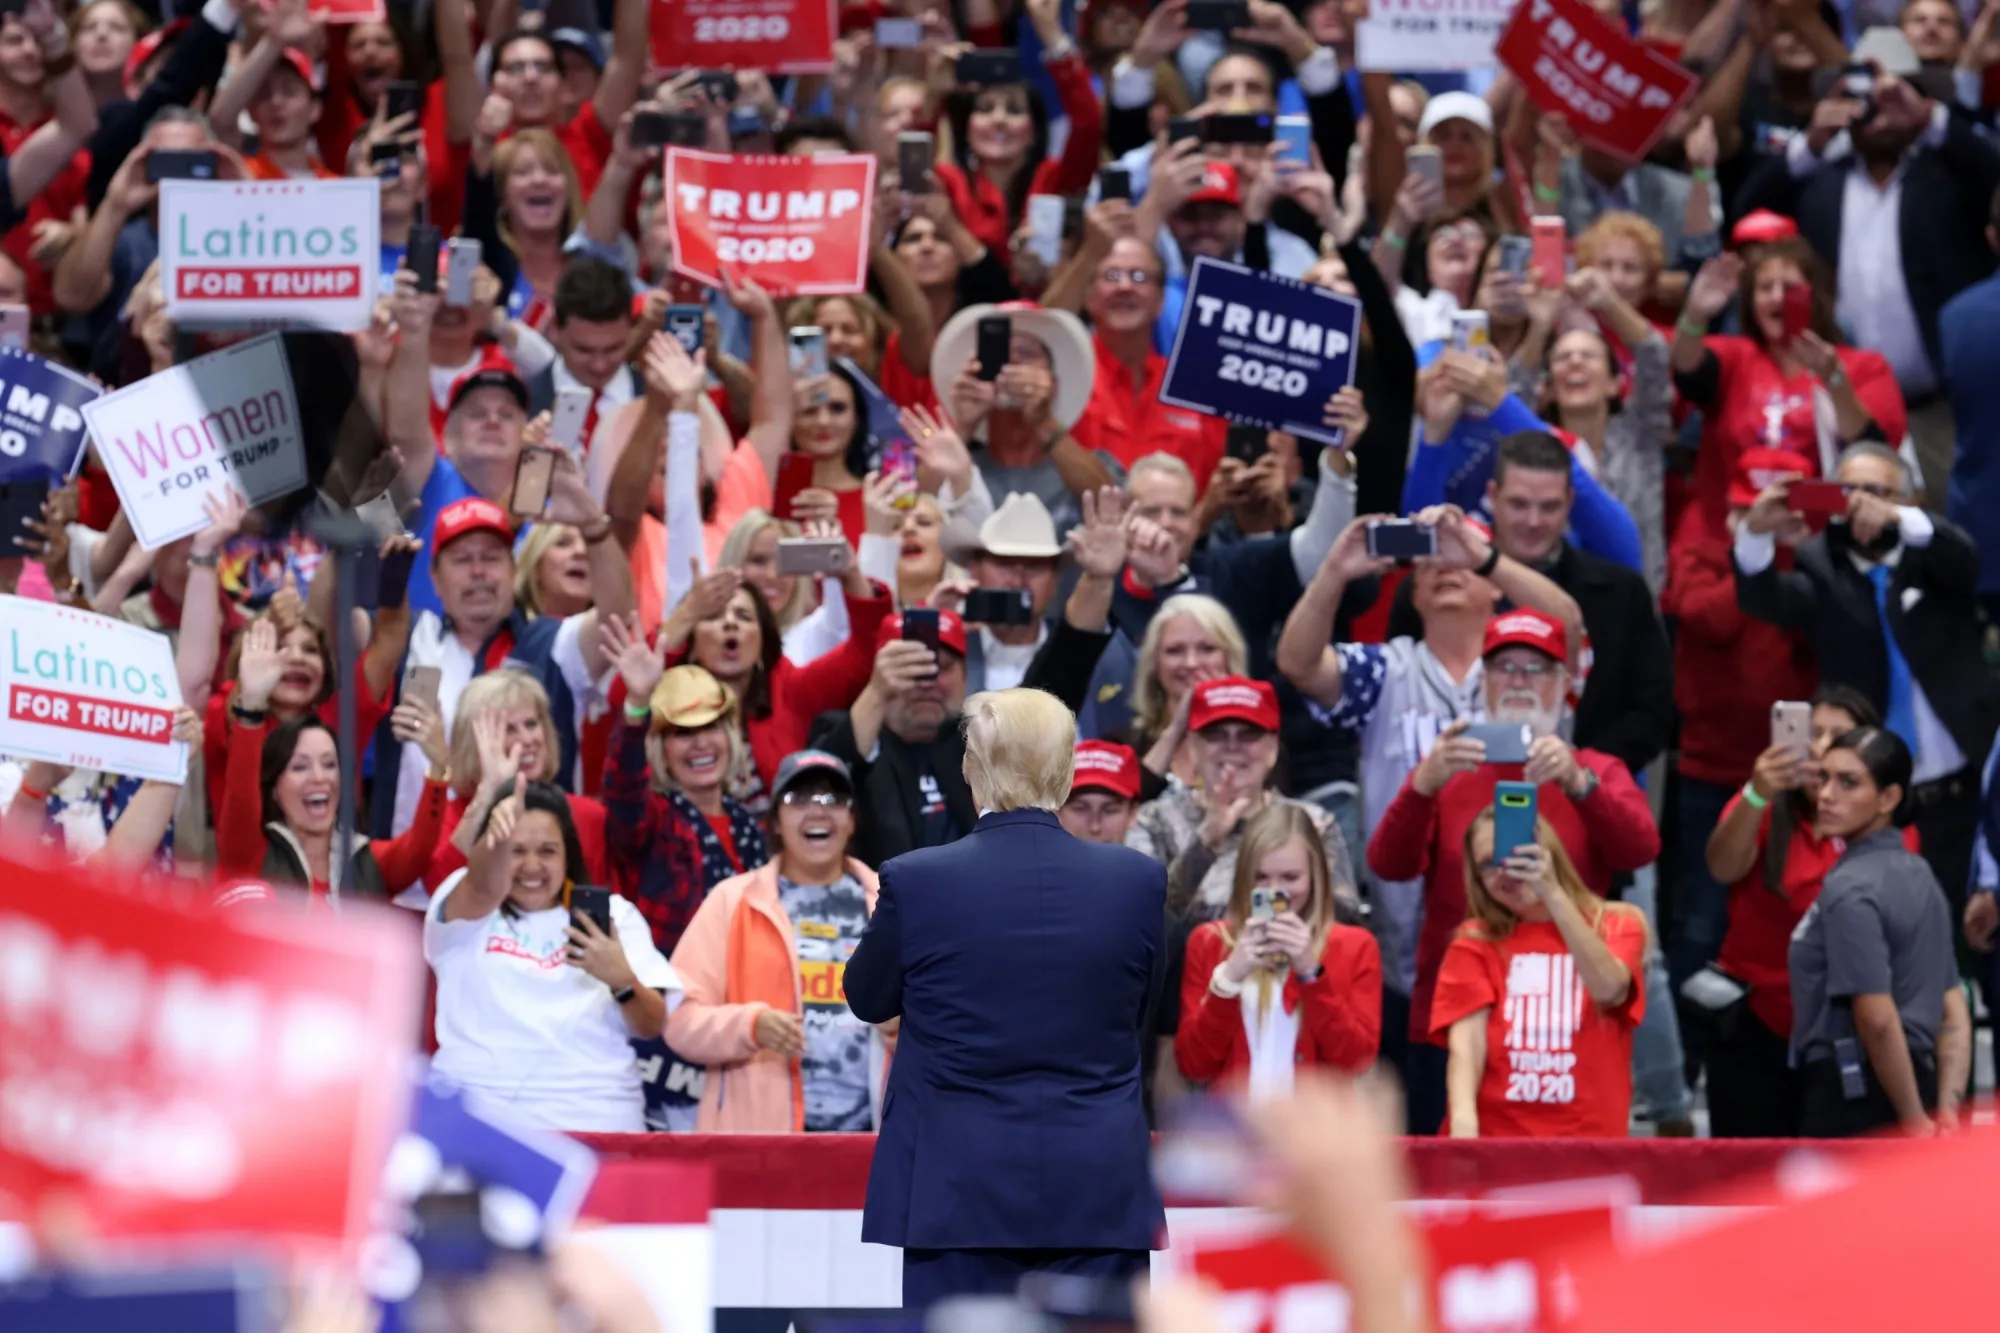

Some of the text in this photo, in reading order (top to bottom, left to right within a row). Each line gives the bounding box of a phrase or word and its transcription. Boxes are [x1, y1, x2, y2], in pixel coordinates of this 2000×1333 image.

[693, 15, 789, 41] 2020
[1530, 0, 1672, 108] TRUMP
[1533, 54, 1614, 124] 2020
[677, 182, 860, 221] TRUMP
[179, 212, 359, 259] Latinos
[716, 236, 815, 264] 2020
[183, 270, 354, 296] FOR TRUMP
[1197, 294, 1350, 360] TRUMP
[1218, 354, 1308, 397] 2020
[0, 379, 82, 433] MP
[116, 389, 288, 480] Women
[159, 436, 280, 497] FOR TRUMP
[12, 628, 168, 699] Latinos
[16, 691, 168, 737] FOR TRUMP
[1508, 1051, 1577, 1074] TRUMP
[1505, 1072, 1575, 1103] 2020
